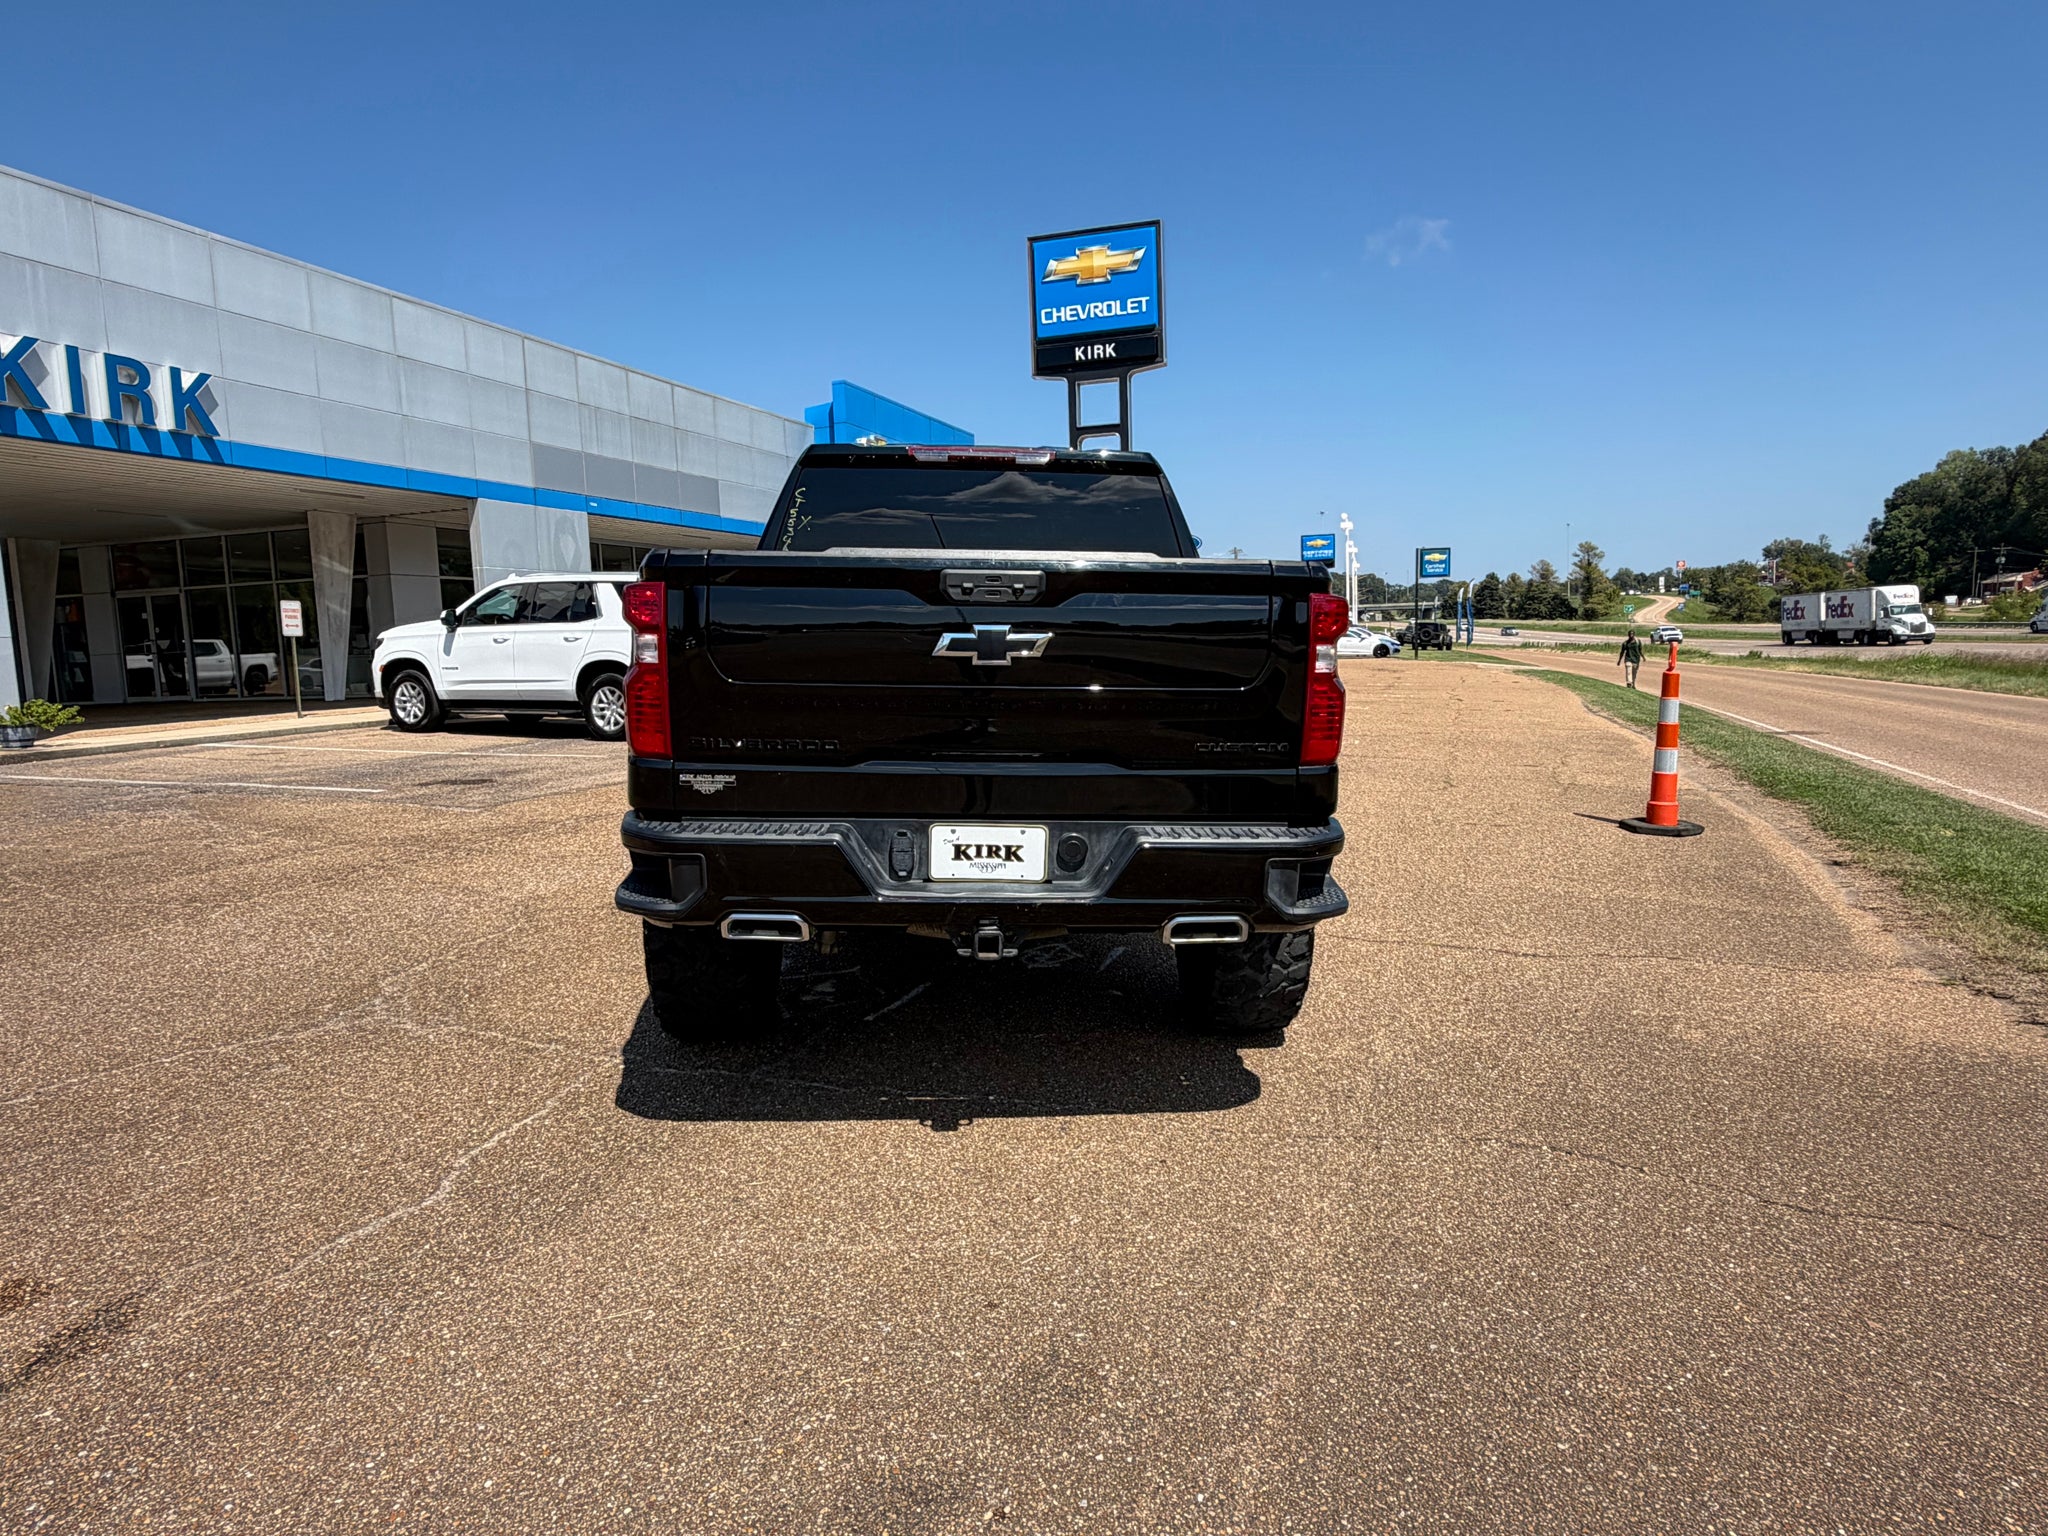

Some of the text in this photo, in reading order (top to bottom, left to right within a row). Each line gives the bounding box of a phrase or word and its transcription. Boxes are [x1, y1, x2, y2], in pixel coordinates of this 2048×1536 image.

[1040, 296, 1150, 325] CHEVROLET
[1074, 343, 1117, 362] KIRK
[0, 335, 221, 437] KIRK
[1782, 599, 1806, 621] FedEx
[1826, 595, 1855, 619] FedEx
[951, 843, 1025, 862] KIRK
